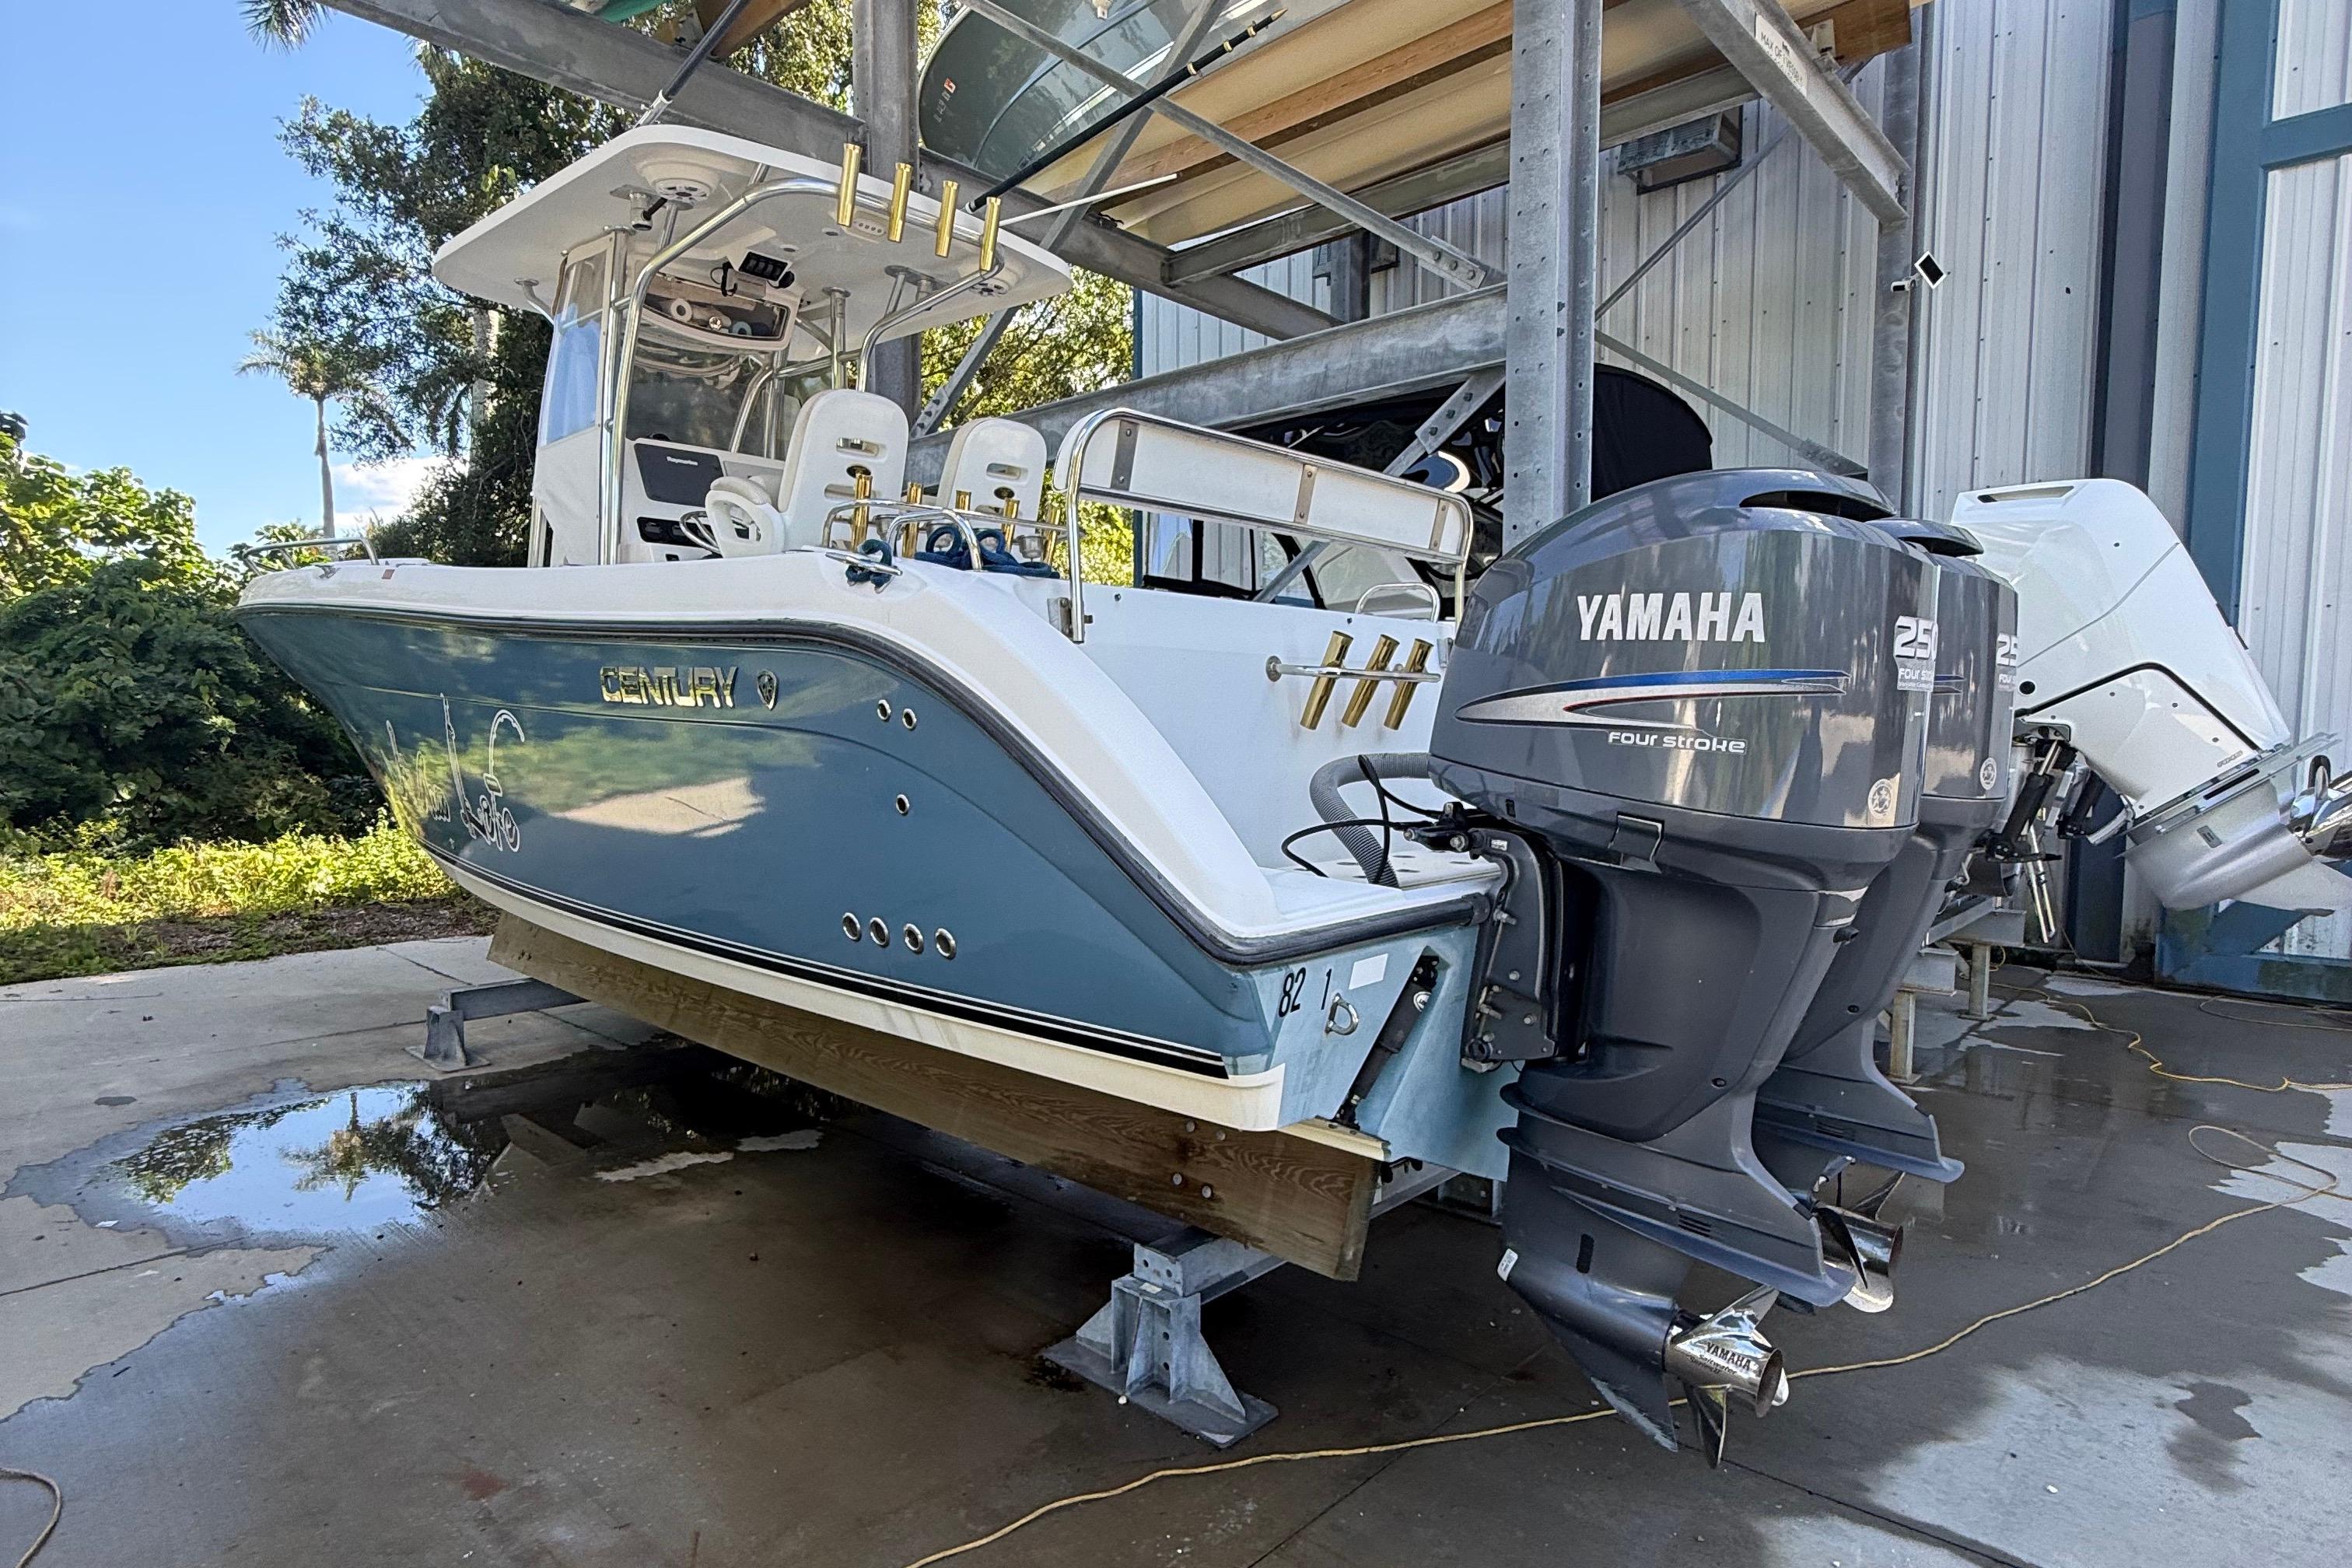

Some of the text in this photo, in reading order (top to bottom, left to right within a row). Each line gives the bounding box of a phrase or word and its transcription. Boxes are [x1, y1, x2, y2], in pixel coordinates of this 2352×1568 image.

[1577, 592, 1766, 643] YAMAHA
[1895, 616, 1939, 660] 250
[600, 666, 739, 709] CENTURY
[1278, 967, 1332, 1018] 82 1
[1706, 1342, 1752, 1371] YAMAHA
